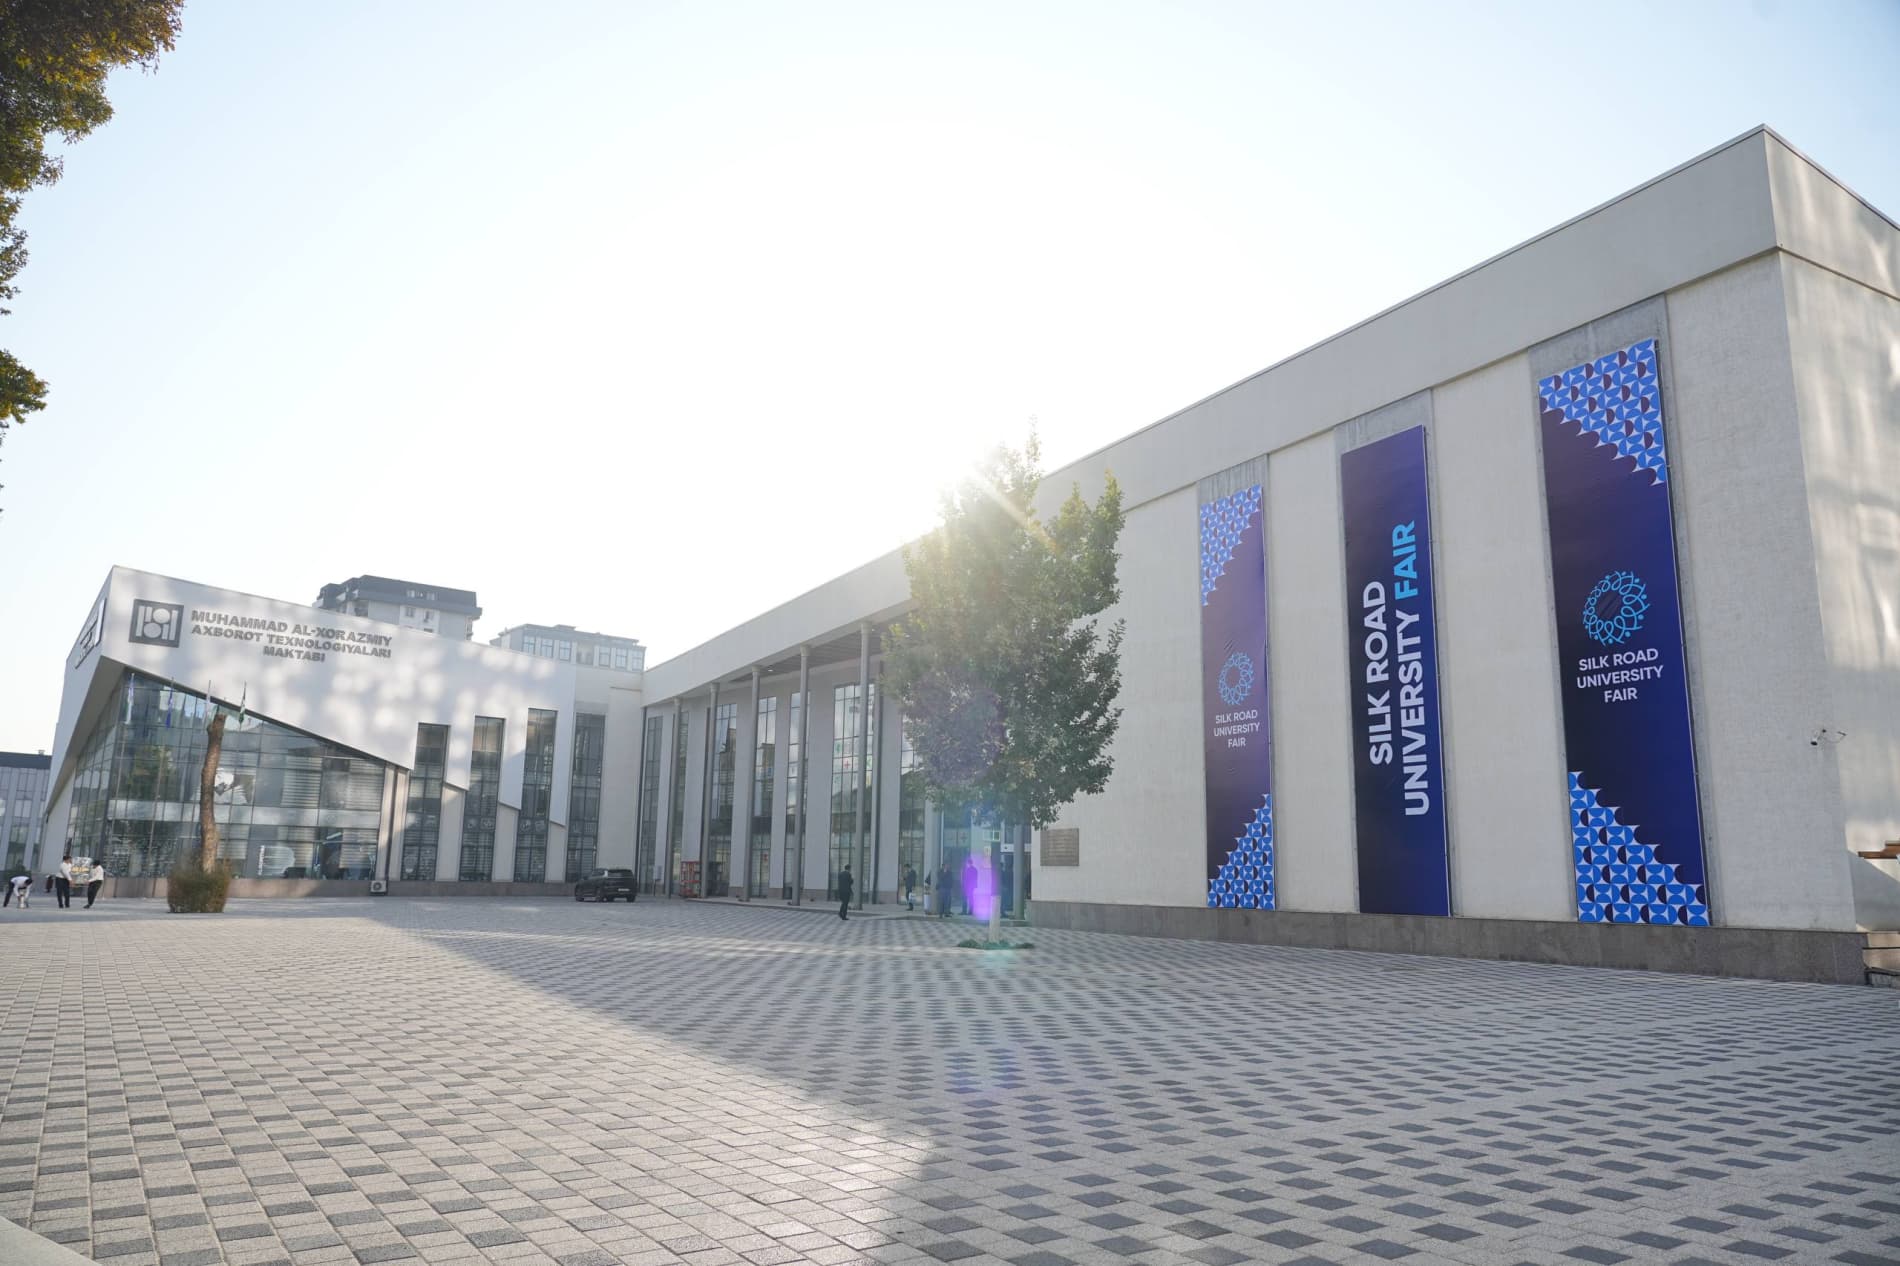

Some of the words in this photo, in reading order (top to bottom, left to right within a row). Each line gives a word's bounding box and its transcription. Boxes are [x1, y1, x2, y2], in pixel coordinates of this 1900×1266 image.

[1391, 520, 1419, 600] FAIR
[191, 609, 288, 633] MUHAMMAD
[291, 623, 393, 647] AL-XORAZMIY
[1363, 581, 1389, 684] ROAD
[191, 624, 264, 642] AXBOROT
[266, 633, 392, 659] TEXNOLOGIYALARI
[263, 645, 326, 663] MAKTABI
[1578, 655, 1610, 671] SILK
[1612, 647, 1659, 667] ROAD
[1576, 664, 1664, 689] UNIVERSITY
[1603, 687, 1638, 703] FAIR
[1215, 712, 1232, 724] SILK
[1233, 709, 1258, 721] ROAD
[1395, 608, 1430, 816] UNIVERSITY
[1213, 721, 1260, 737] UNIVERSITY
[1367, 689, 1393, 765] SILK
[1227, 737, 1246, 749] FAIR
